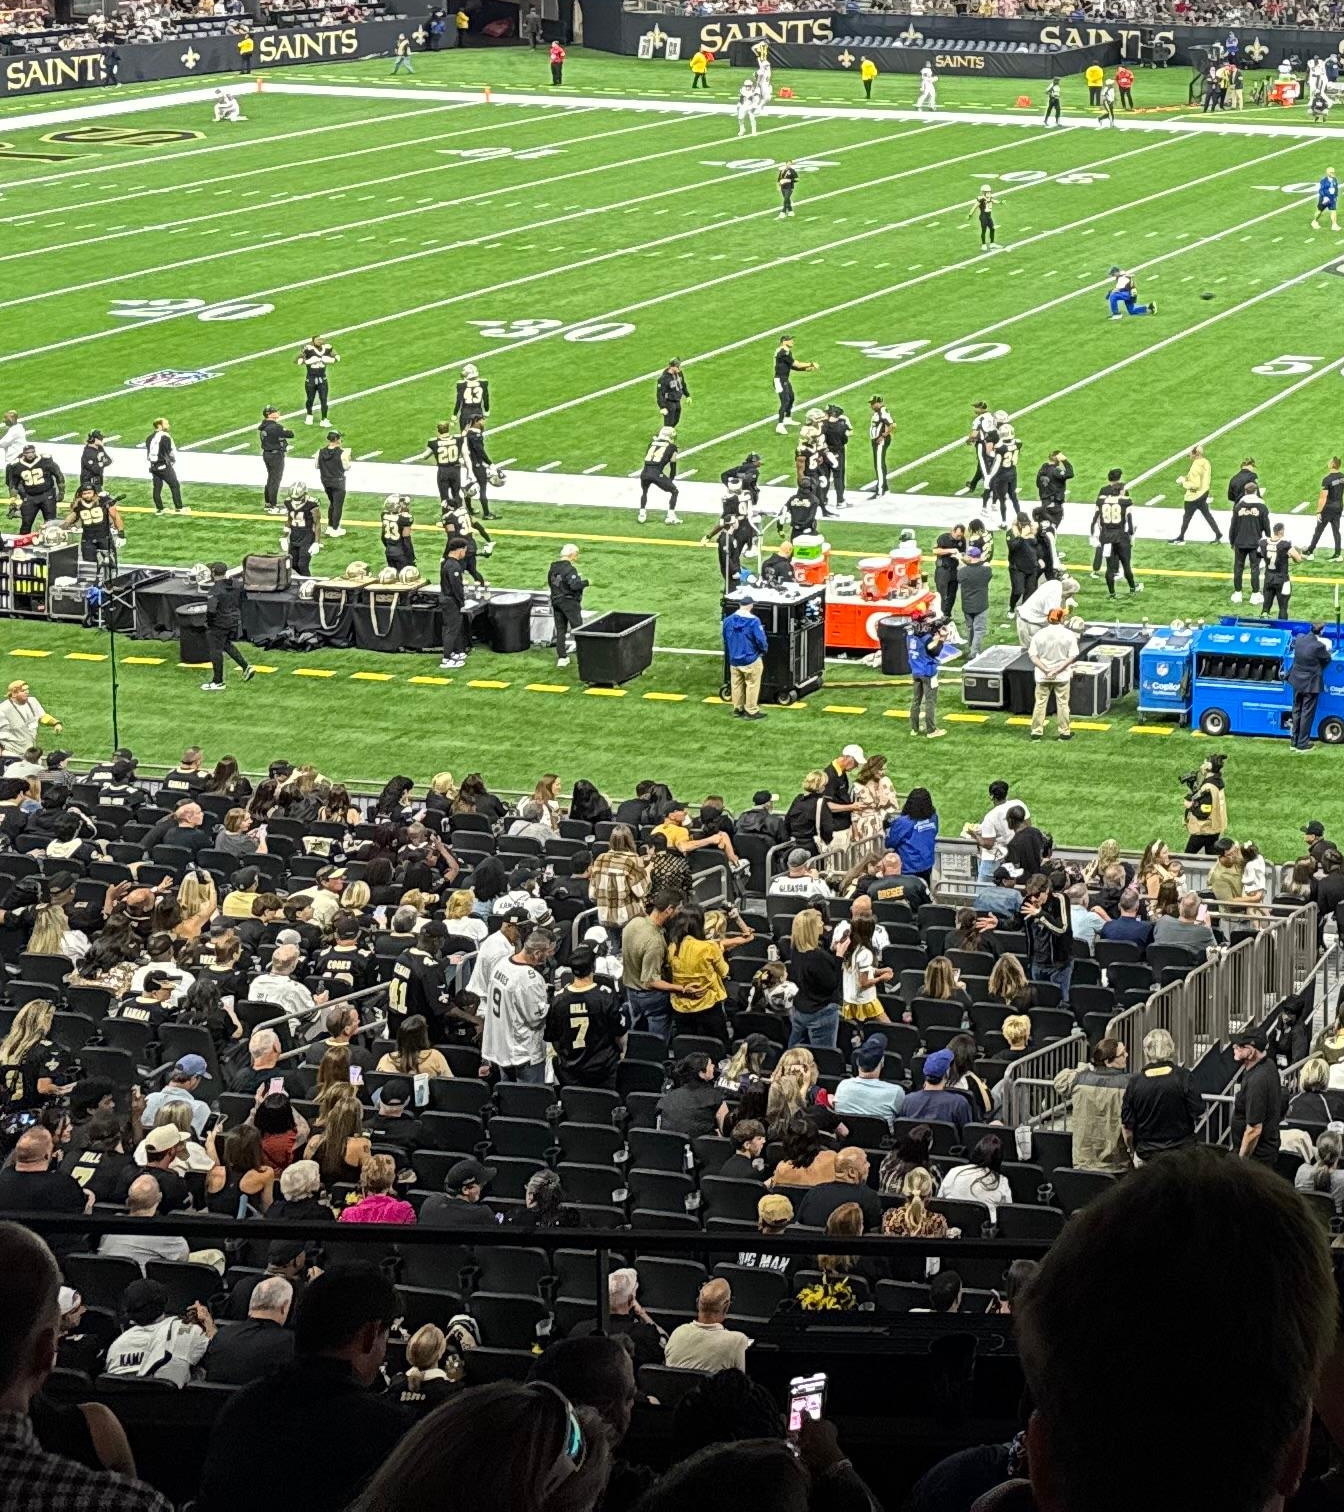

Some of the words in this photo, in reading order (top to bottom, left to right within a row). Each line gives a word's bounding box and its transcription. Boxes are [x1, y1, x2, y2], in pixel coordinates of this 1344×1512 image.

[259, 29, 358, 63] SAINTS
[701, 17, 833, 51] SAINTS
[934, 54, 985, 68] SAINTS
[107, 298, 276, 322] 20
[480, 318, 637, 343] 30
[861, 339, 1012, 363] 40
[436, 443, 460, 465] 20
[19, 466, 46, 487] 92
[79, 507, 104, 526] 99
[570, 1016, 590, 1048] 7
